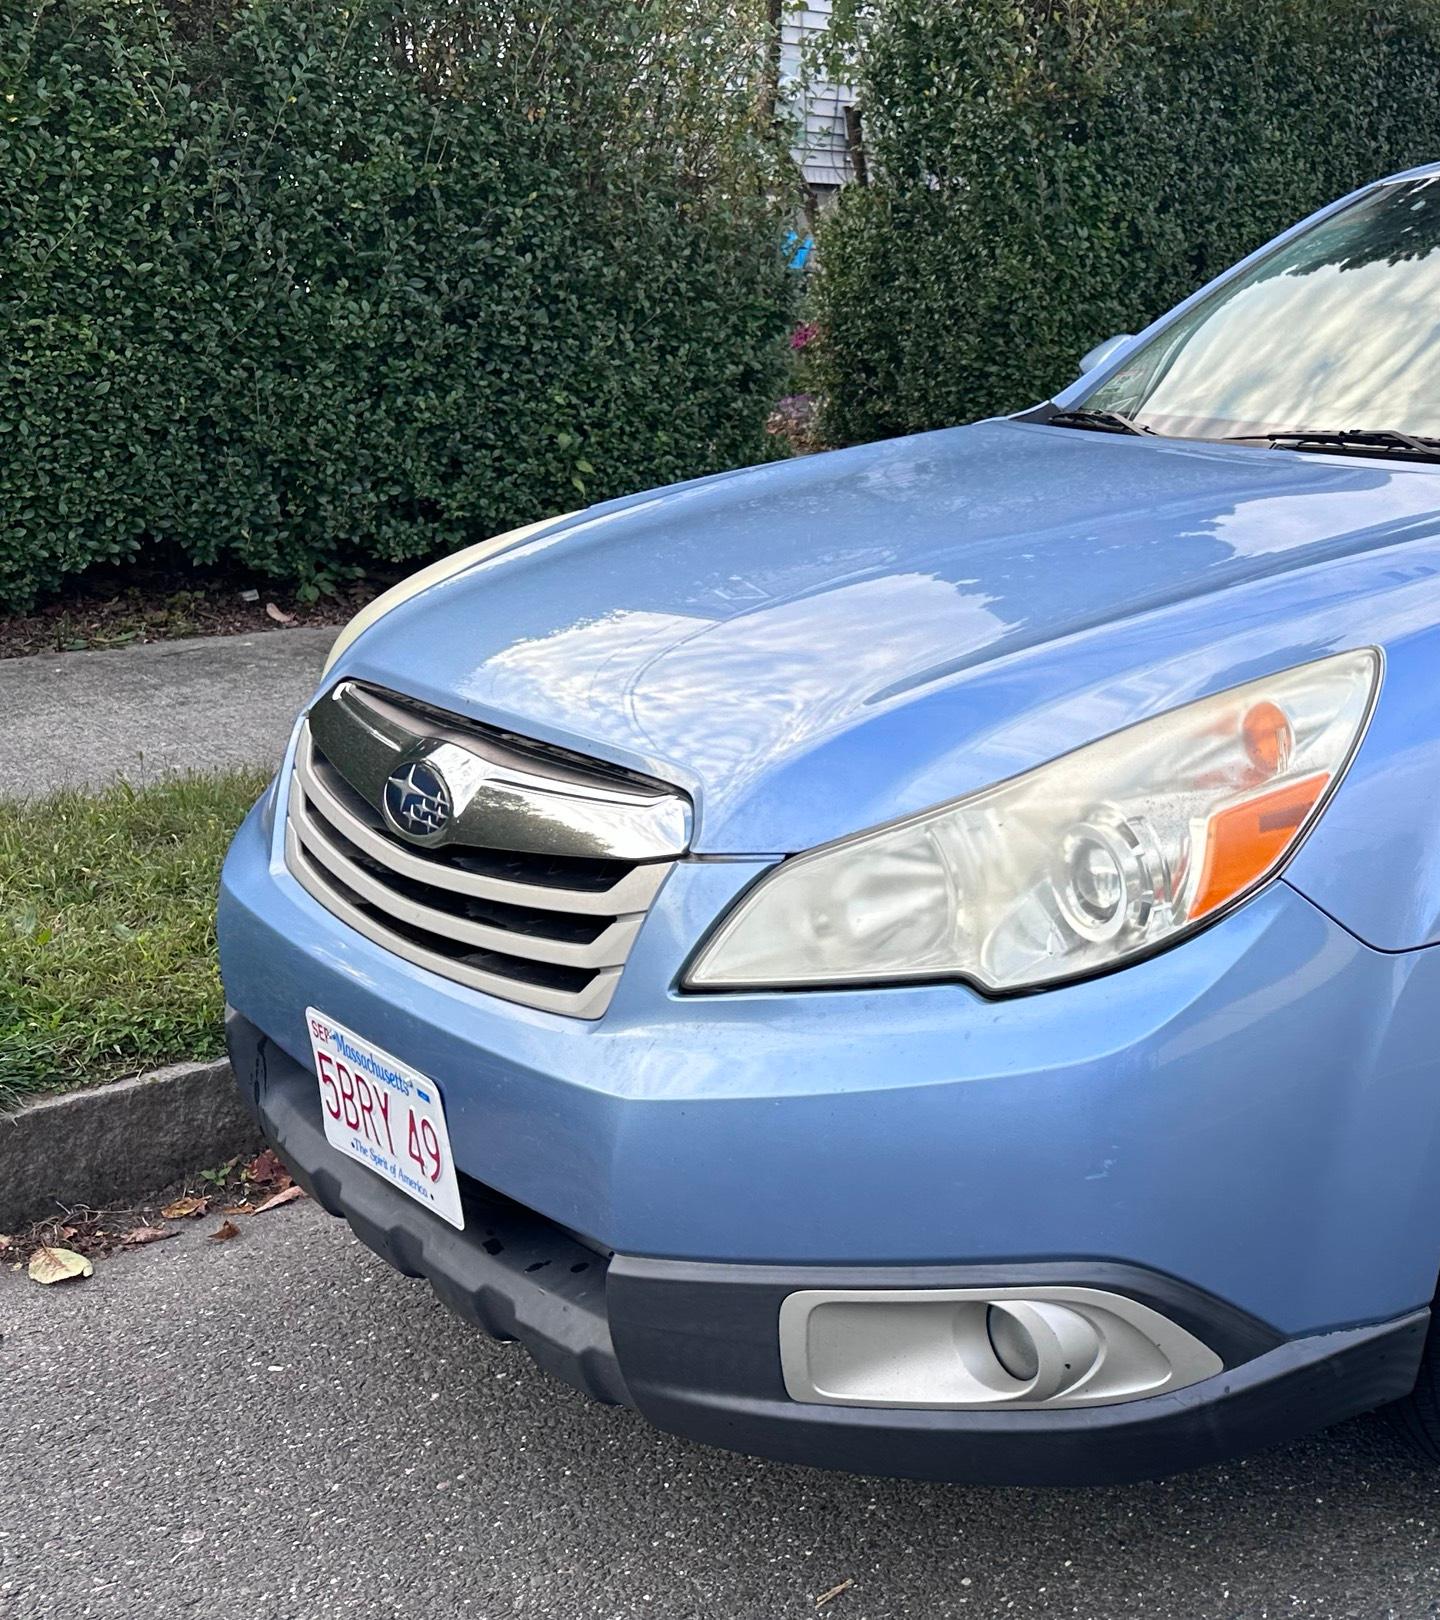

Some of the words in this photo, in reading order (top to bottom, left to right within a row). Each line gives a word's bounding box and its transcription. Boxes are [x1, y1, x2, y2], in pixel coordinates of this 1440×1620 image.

[311, 1019, 330, 1042] SEP
[335, 1030, 410, 1097] Massachusetts
[318, 1051, 395, 1156] 5BRY
[408, 1109, 441, 1182] 49
[353, 1137, 369, 1157] The
[369, 1147, 388, 1170] Spirit
[390, 1163, 397, 1178] of
[398, 1168, 429, 1199] America
